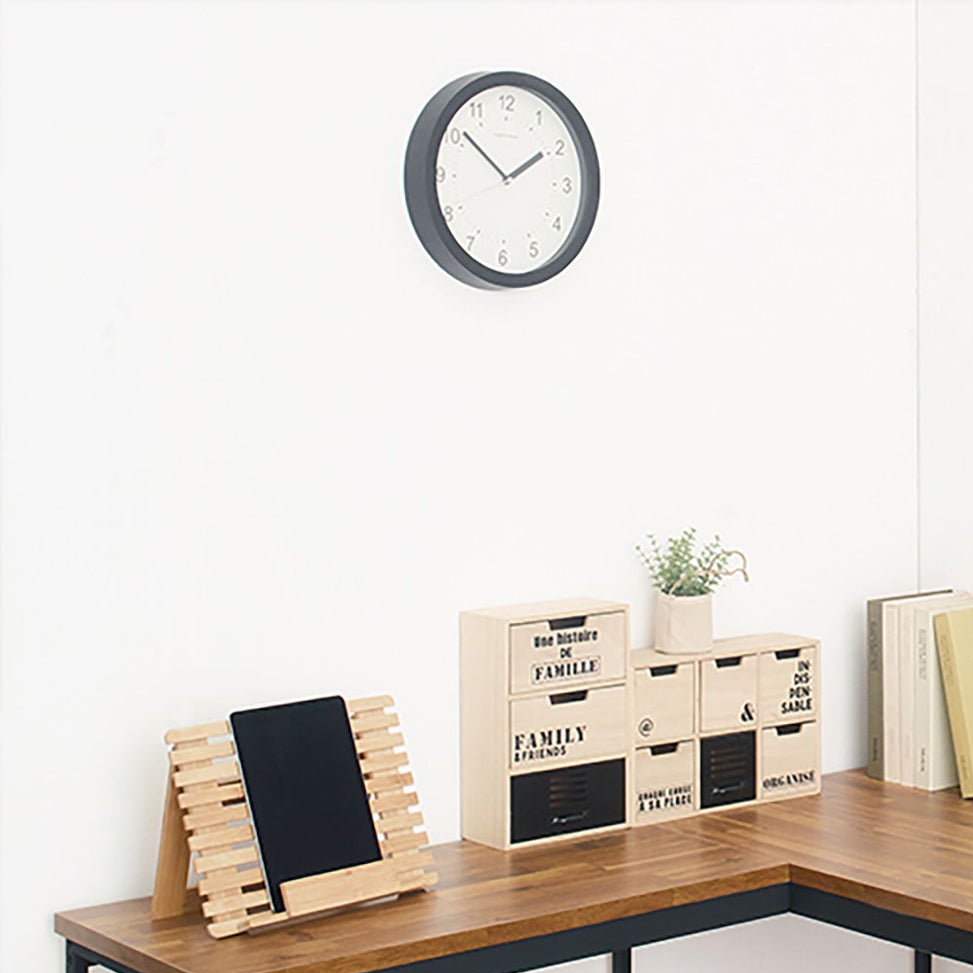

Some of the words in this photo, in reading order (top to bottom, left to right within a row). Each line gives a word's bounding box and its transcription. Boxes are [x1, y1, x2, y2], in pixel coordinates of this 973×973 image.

[469, 102, 483, 118] 11
[499, 94, 515, 112] 12
[535, 110, 542, 125] 1
[554, 139, 565, 156] 2
[436, 166, 446, 183] 9
[562, 177, 572, 194] 3
[444, 205, 454, 222] 8
[552, 216, 561, 231] 4
[466, 235, 476, 251] 7
[528, 241, 539, 258] 5
[498, 250, 508, 266] 6
[534, 634, 554, 648] Une
[556, 629, 598, 645] histoire
[559, 647, 572, 659] DE
[534, 659, 598, 682] FAMILLE
[781, 698, 812, 714] SABLE
[514, 725, 587, 751] FAMILY
[762, 770, 815, 789] ORGANISE
[649, 799, 661, 811] SA
[664, 794, 692, 807] PLACE
